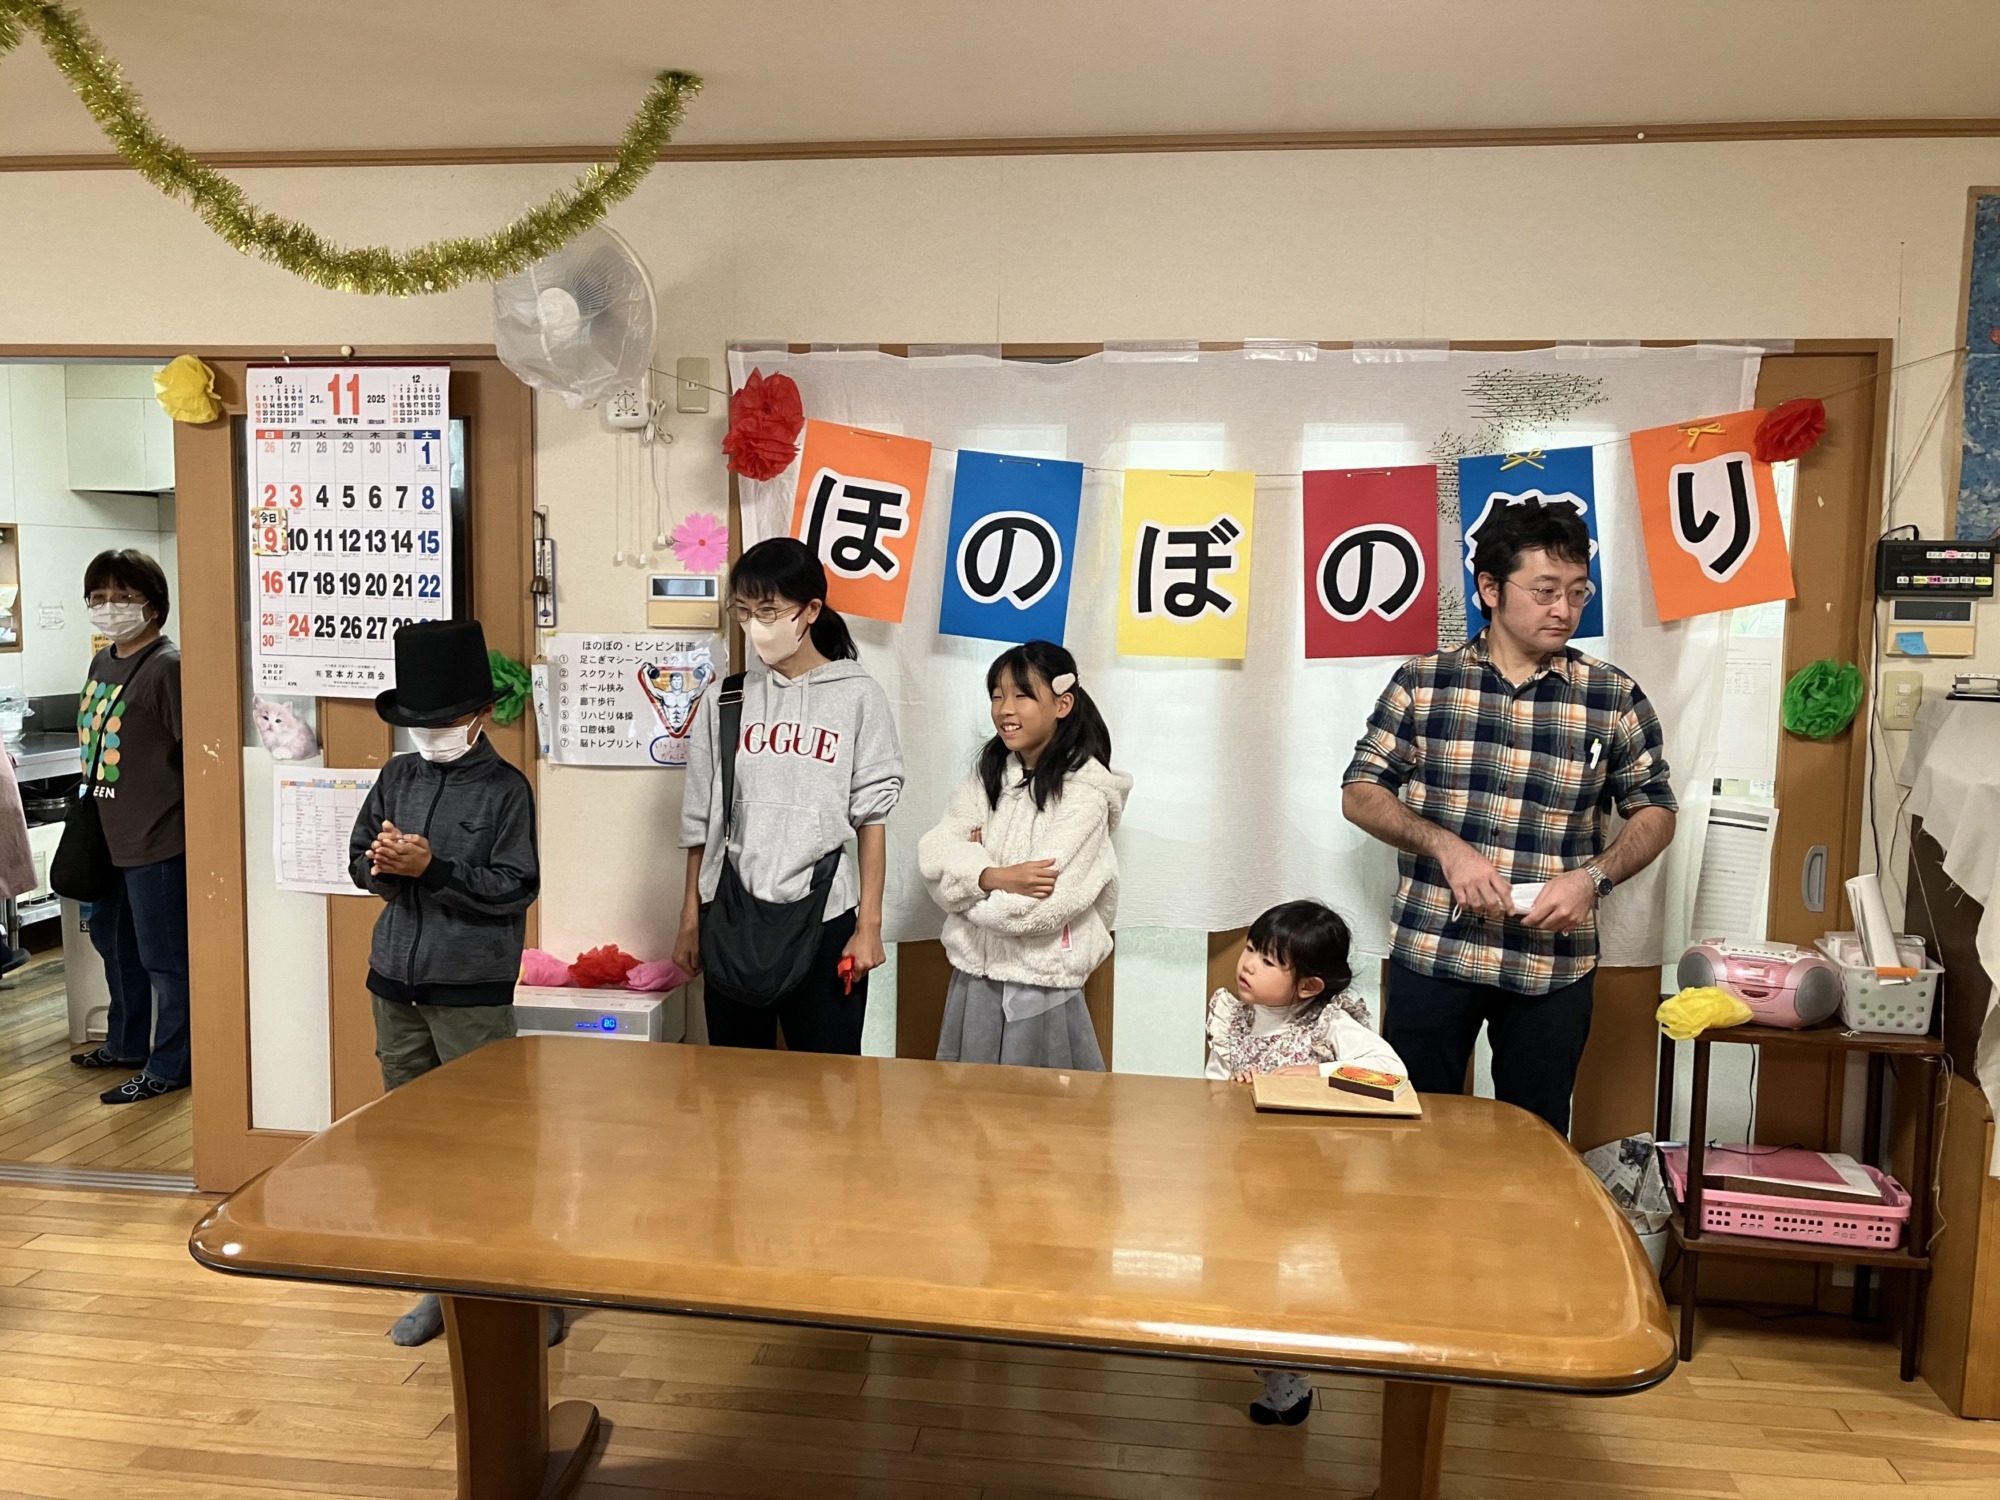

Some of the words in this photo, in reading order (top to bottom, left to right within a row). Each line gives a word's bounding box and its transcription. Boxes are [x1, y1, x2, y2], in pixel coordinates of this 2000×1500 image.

[274, 376, 283, 384] 10
[412, 375, 420, 383] 12
[327, 374, 360, 415] 11
[367, 394, 385, 403] 2025
[264, 441, 275, 453] 26
[290, 441, 301, 453] 27
[316, 441, 327, 453] 28
[342, 441, 354, 453] 29
[369, 442, 381, 454] 30
[397, 441, 407, 454] 31
[422, 441, 430, 464] 1
[264, 484, 277, 506] 2
[290, 484, 303, 508] 3
[316, 485, 329, 508] 4
[342, 485, 355, 508] 5
[369, 485, 382, 509] 6
[396, 486, 408, 509] 7
[422, 486, 434, 509] 8
[259, 512, 276, 523] 今日
[264, 528, 277, 551] 9
[287, 528, 308, 551] 10
[314, 529, 332, 551] 11
[339, 529, 361, 552] 12
[365, 529, 386, 553] 13
[391, 530, 413, 553] 14
[418, 530, 440, 553] 15
[262, 571, 283, 594] 16
[287, 571, 308, 594] 17
[313, 572, 335, 595] 18
[339, 573, 361, 596] 19
[365, 573, 387, 596] 20
[393, 573, 412, 597] 21
[418, 574, 440, 598] 22
[262, 613, 274, 626] 23
[289, 614, 310, 637] 24
[314, 615, 336, 638] 25
[340, 616, 362, 639] 26
[366, 616, 387, 640] 27
[262, 634, 274, 647] 30
[580, 655, 643, 665] 足こぎマシーン
[580, 670, 624, 678] スクワット
[580, 684, 624, 692] ボール挟み
[580, 697, 615, 706] 廊下歩行
[581, 711, 633, 720] リハビリ体操
[580, 725, 615, 734] 口腔体操
[580, 739, 642, 748] 脳トレプリント
